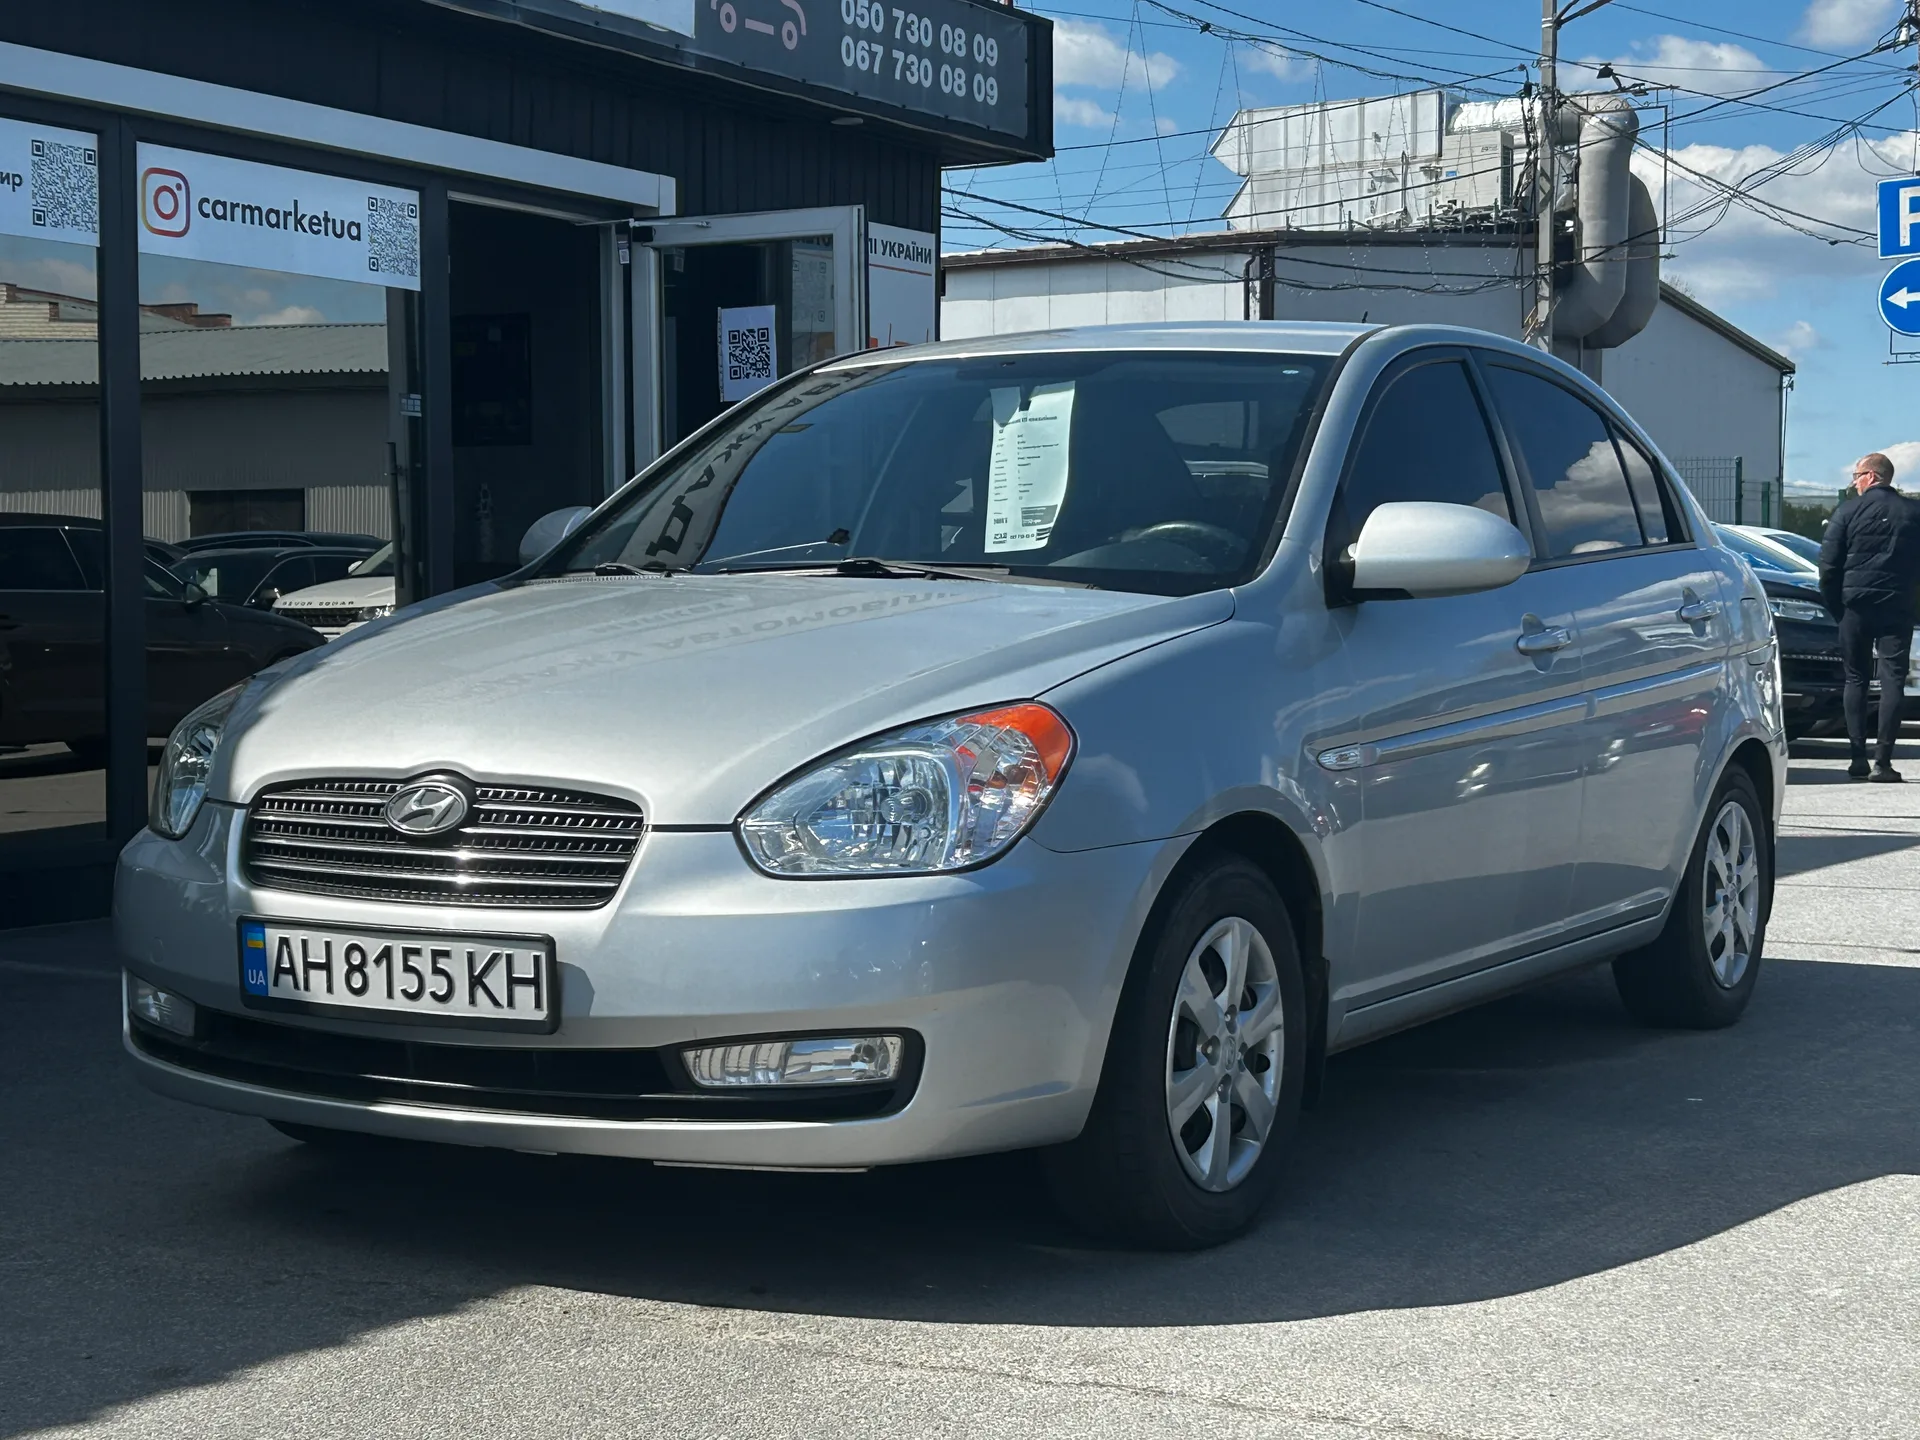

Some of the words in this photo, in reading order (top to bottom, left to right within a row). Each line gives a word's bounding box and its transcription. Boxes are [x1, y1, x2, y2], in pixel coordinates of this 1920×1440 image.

[841, 0, 884, 34] 050
[892, 8, 933, 47] 730
[940, 24, 967, 57] 08
[973, 33, 998, 67] 09
[841, 35, 884, 75] 067
[892, 50, 933, 88] 730
[940, 64, 967, 97] 08
[973, 73, 998, 106] 09
[198, 195, 362, 242] carmarketua
[881, 239, 932, 265] УКРАЇНИ
[248, 968, 266, 986] UA
[343, 940, 455, 1004] 8155
